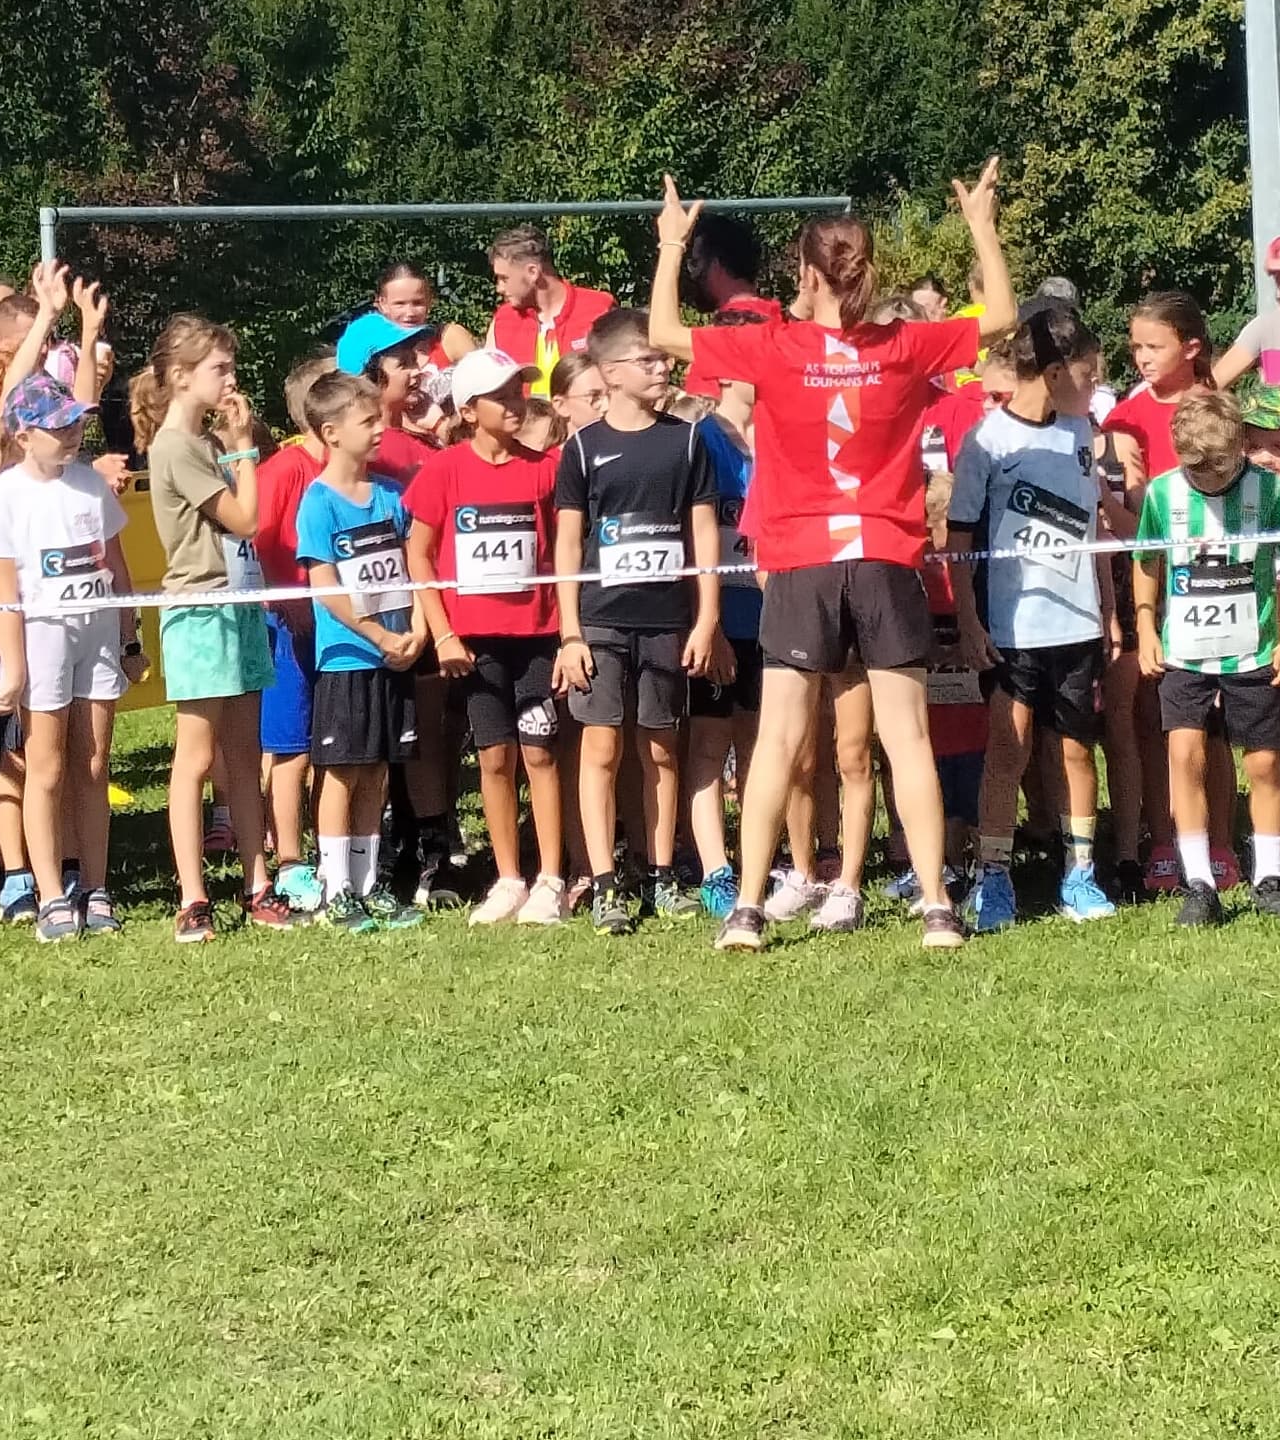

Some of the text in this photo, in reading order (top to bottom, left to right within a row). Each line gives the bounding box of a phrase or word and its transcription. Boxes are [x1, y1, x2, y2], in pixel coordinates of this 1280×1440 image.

[472, 539, 524, 562] 441
[616, 549, 670, 573] 437
[358, 558, 400, 584] 402
[60, 578, 106, 601] 420
[1184, 603, 1238, 628] 421
